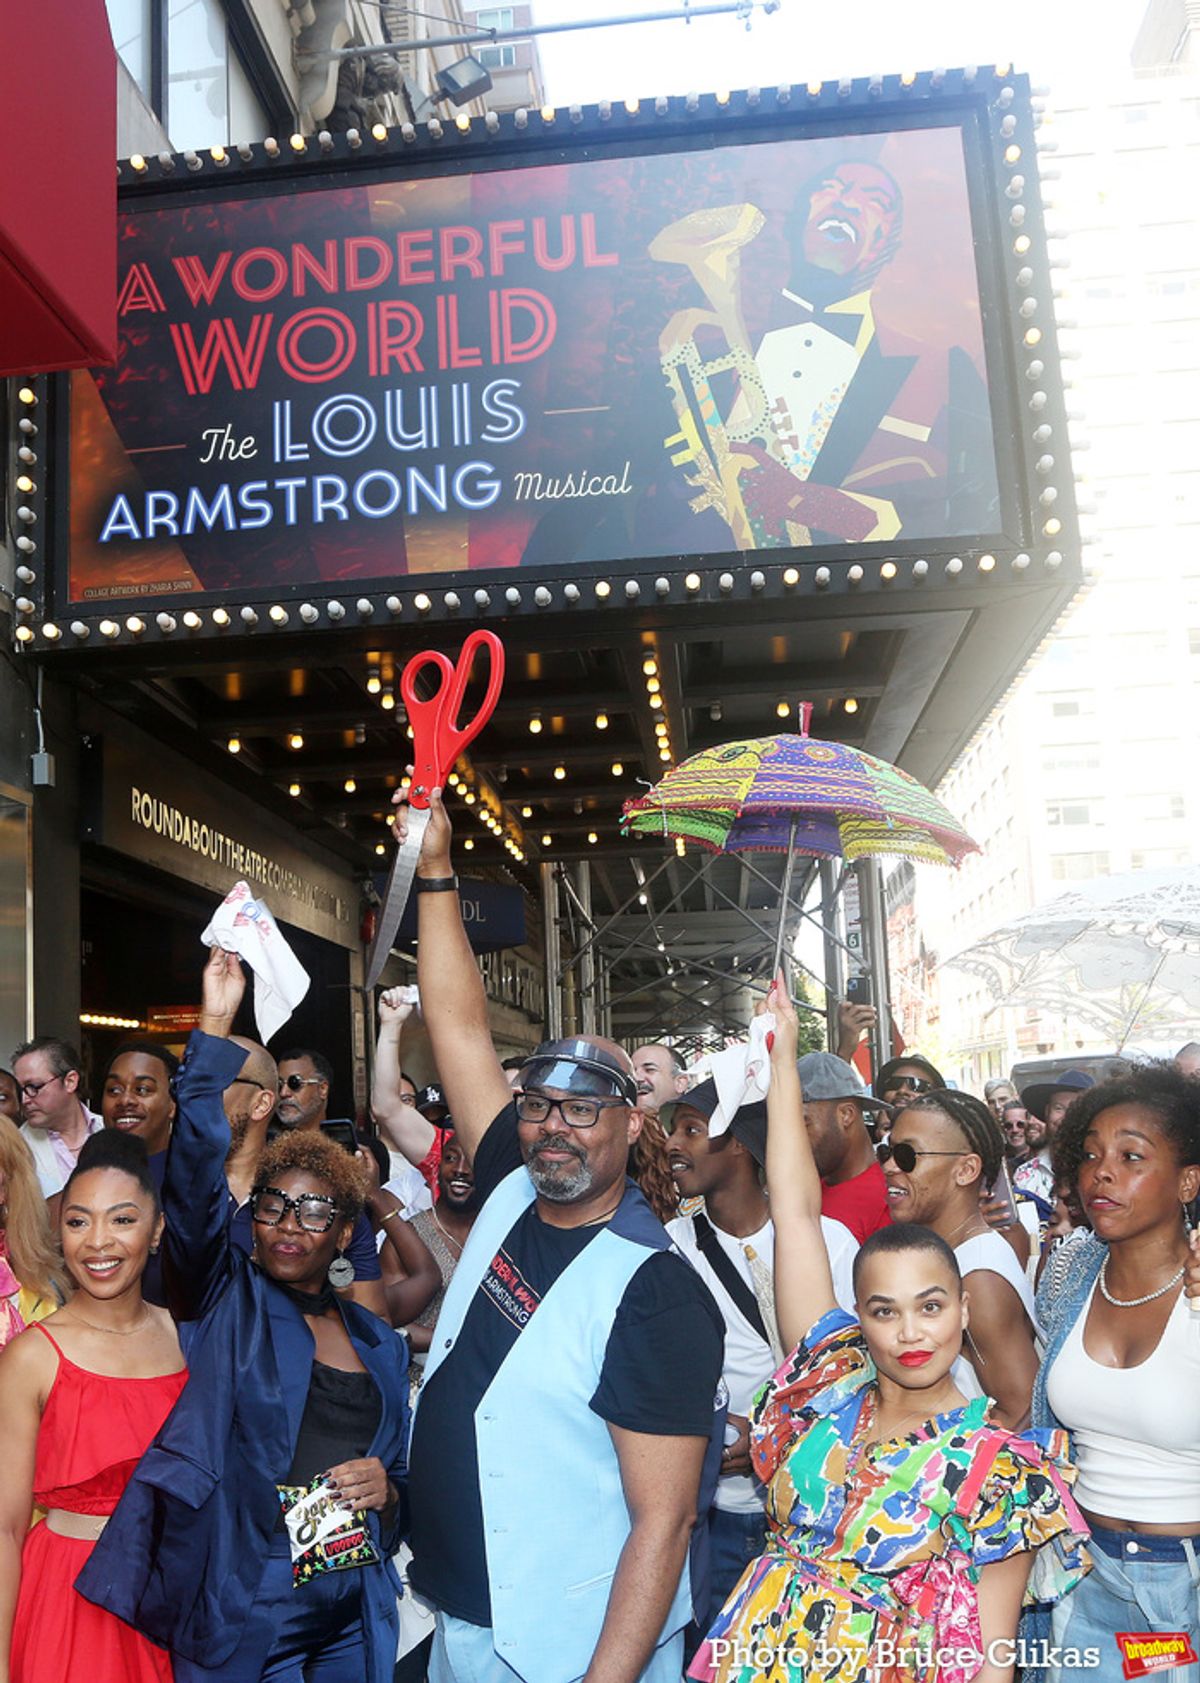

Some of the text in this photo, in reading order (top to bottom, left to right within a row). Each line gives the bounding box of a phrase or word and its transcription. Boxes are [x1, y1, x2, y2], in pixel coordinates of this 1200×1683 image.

[117, 212, 619, 317] A WONDERFUL
[169, 287, 558, 395] WORLD
[200, 378, 526, 464] The LOUIS
[98, 460, 632, 543] ARMSTRONG Musical
[131, 786, 224, 863] ROUNDABOUT
[225, 837, 267, 884] THEATRE
